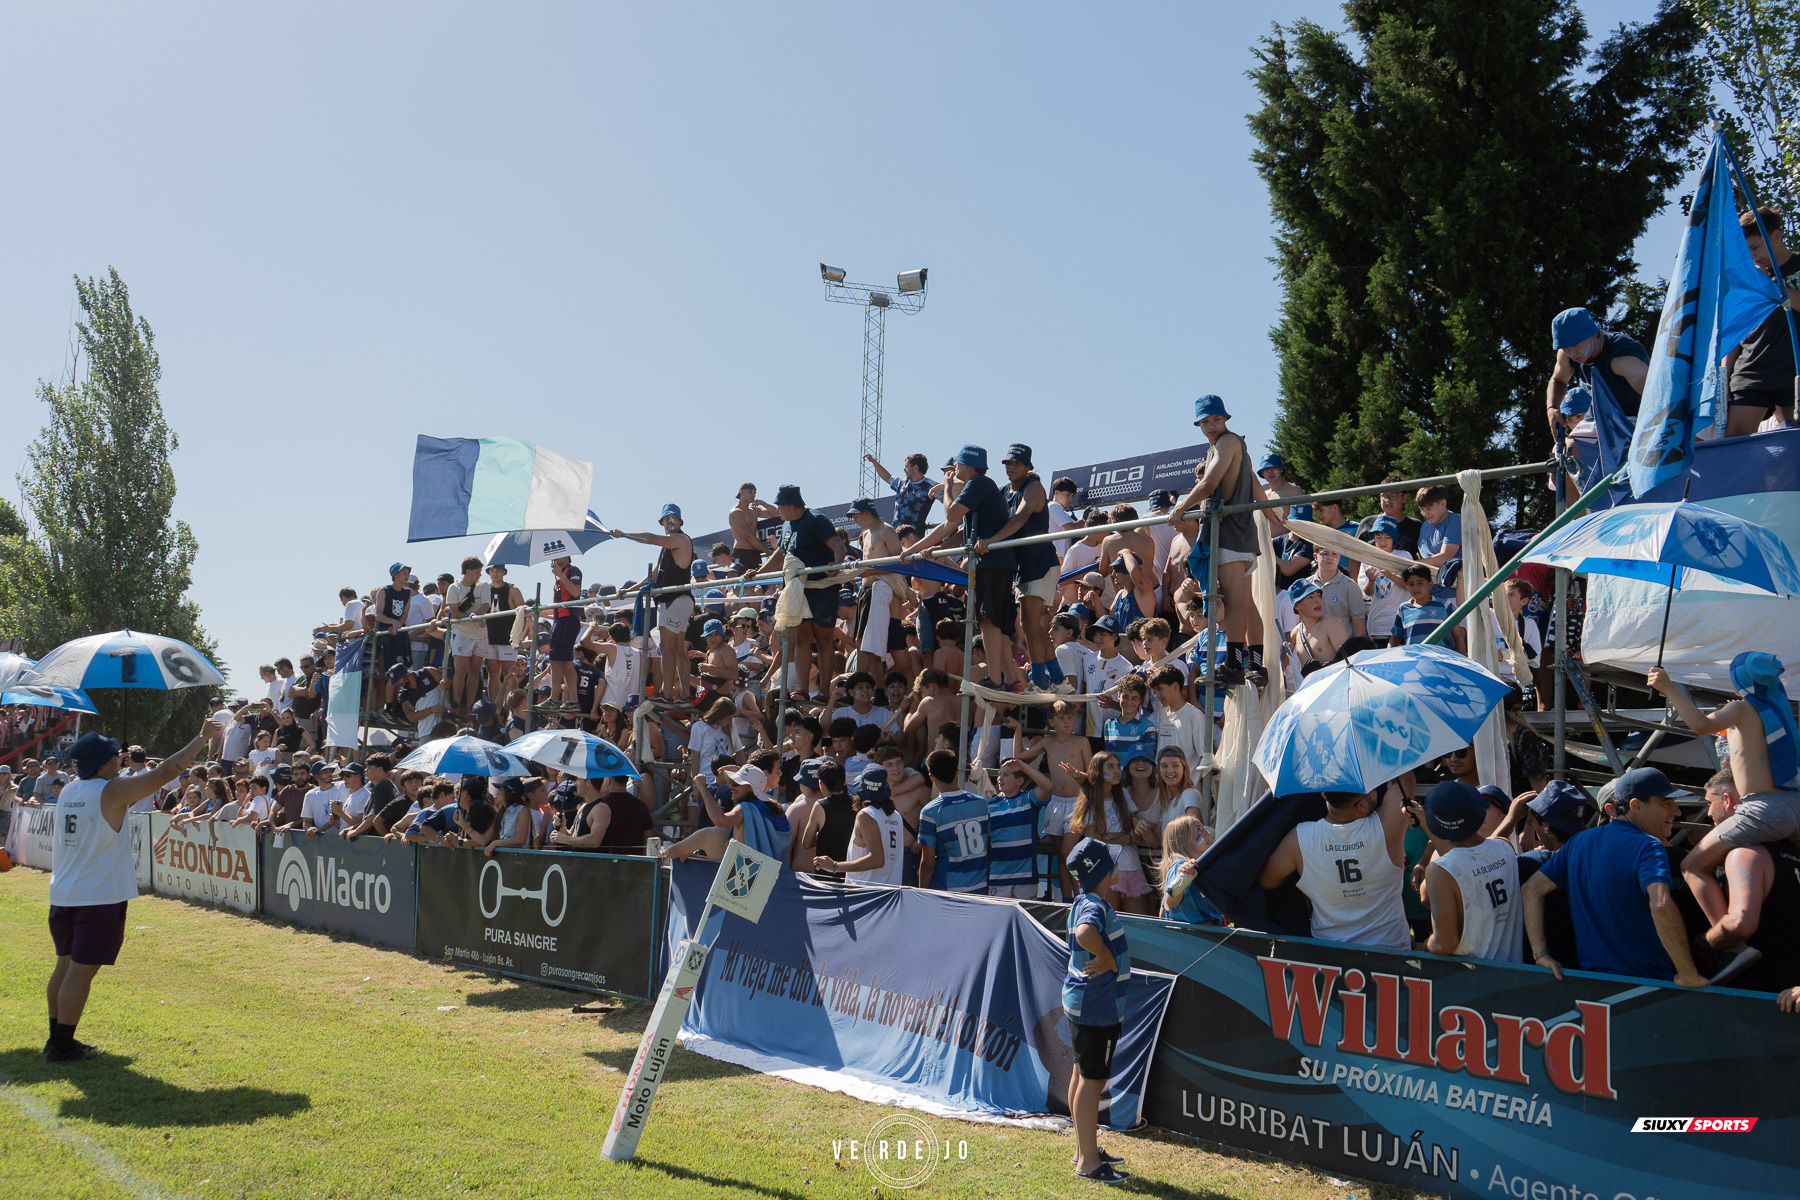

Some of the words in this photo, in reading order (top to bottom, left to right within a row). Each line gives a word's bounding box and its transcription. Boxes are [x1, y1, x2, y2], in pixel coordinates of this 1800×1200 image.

[1089, 465, 1144, 488] inca
[1155, 470, 1181, 479] ANDAMIOS
[1182, 468, 1196, 476] MULTI
[1156, 460, 1182, 470] AISLACIÓN
[1183, 457, 1204, 466] TÉRMICA
[1374, 716, 1408, 740] LRC
[65, 814, 77, 834] 16
[954, 820, 984, 857] 18
[169, 838, 253, 883] HONDA
[1325, 844, 1334, 852] LA
[1334, 841, 1365, 851] GLORIOSA
[1336, 858, 1362, 884] 16
[1472, 869, 1480, 877] LA
[1481, 858, 1507, 874] GLORIOSA
[157, 872, 192, 890] MOTO
[202, 881, 252, 905] LUJÁN
[317, 856, 391, 914] Macro
[1485, 878, 1508, 909] 16
[444, 945, 455, 956] San
[455, 947, 470, 959] Martín
[485, 928, 512, 944] PURA
[514, 932, 557, 952] SANGRE
[720, 937, 744, 983] Mi
[738, 944, 771, 1001] vieja
[767, 962, 792, 998] me
[811, 961, 829, 1008] la
[829, 966, 861, 1029] vida,
[862, 973, 880, 1022] la
[878, 988, 942, 1038] noventi
[936, 994, 960, 1044] el
[1256, 955, 1618, 1100] Willard
[622, 1032, 654, 1109] HONDA
[627, 1088, 651, 1128] Moto
[644, 1037, 670, 1083] Luján
[1298, 1056, 1327, 1082] SU
[1332, 1064, 1440, 1104] PRÓXIMA
[1445, 1080, 1553, 1128] BATERÍA
[1181, 1089, 1331, 1149] LUBRIBAT
[1343, 1130, 1459, 1183] LUJÁN
